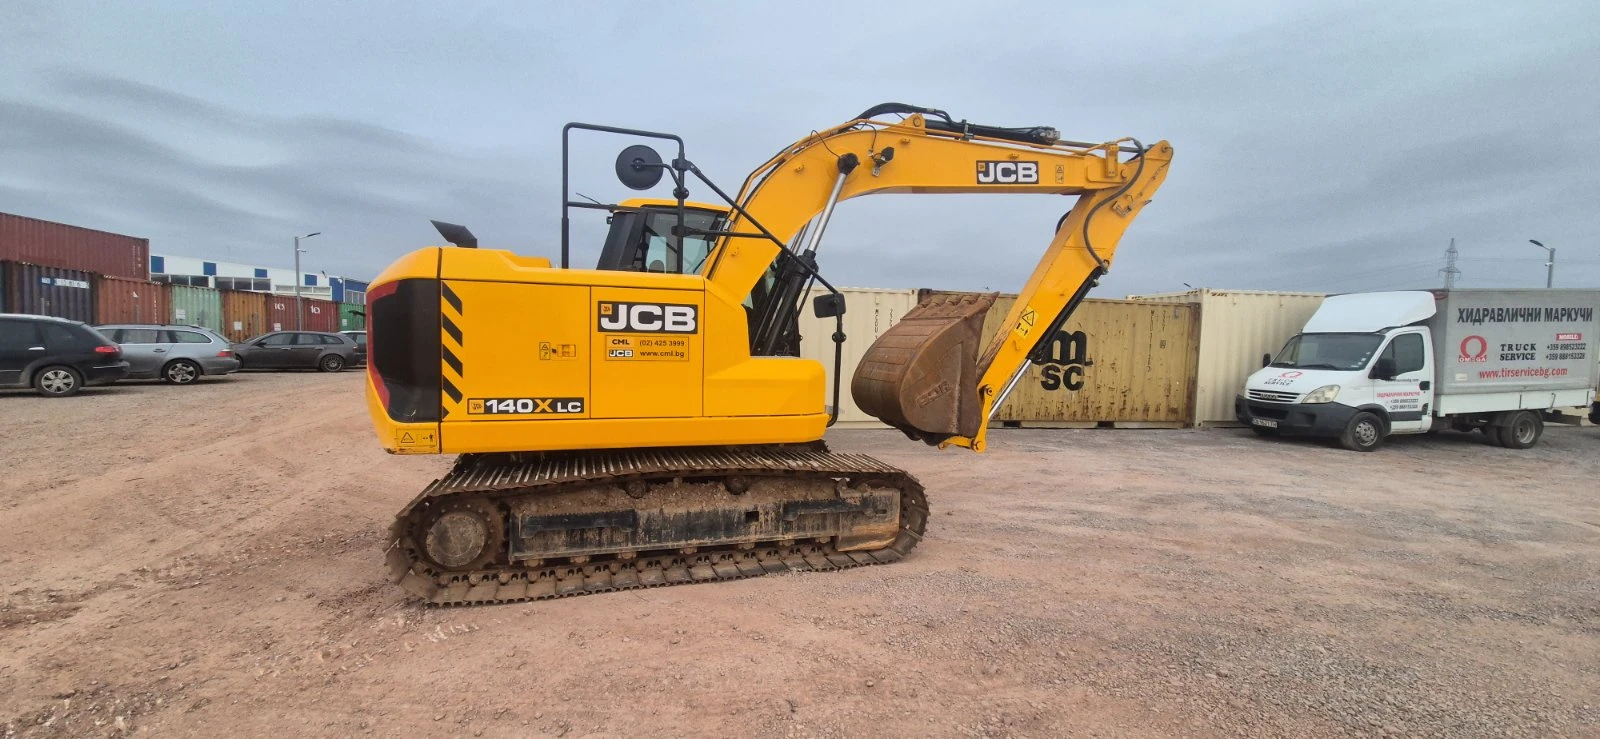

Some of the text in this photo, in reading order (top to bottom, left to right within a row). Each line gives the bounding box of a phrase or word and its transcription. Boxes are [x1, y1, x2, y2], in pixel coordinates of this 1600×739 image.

[978, 162, 1038, 183] JCB
[600, 304, 696, 332] JCB
[1457, 307, 1593, 326] ХИДРАВЛИЧНИ МАРКУЧИ
[639, 350, 685, 358] www.cml.bg
[1500, 343, 1536, 352] TRUCK
[1500, 352, 1535, 361] SERVICE
[1479, 367, 1568, 379] www.tirservicebg.com
[486, 399, 582, 413] 140X LC
